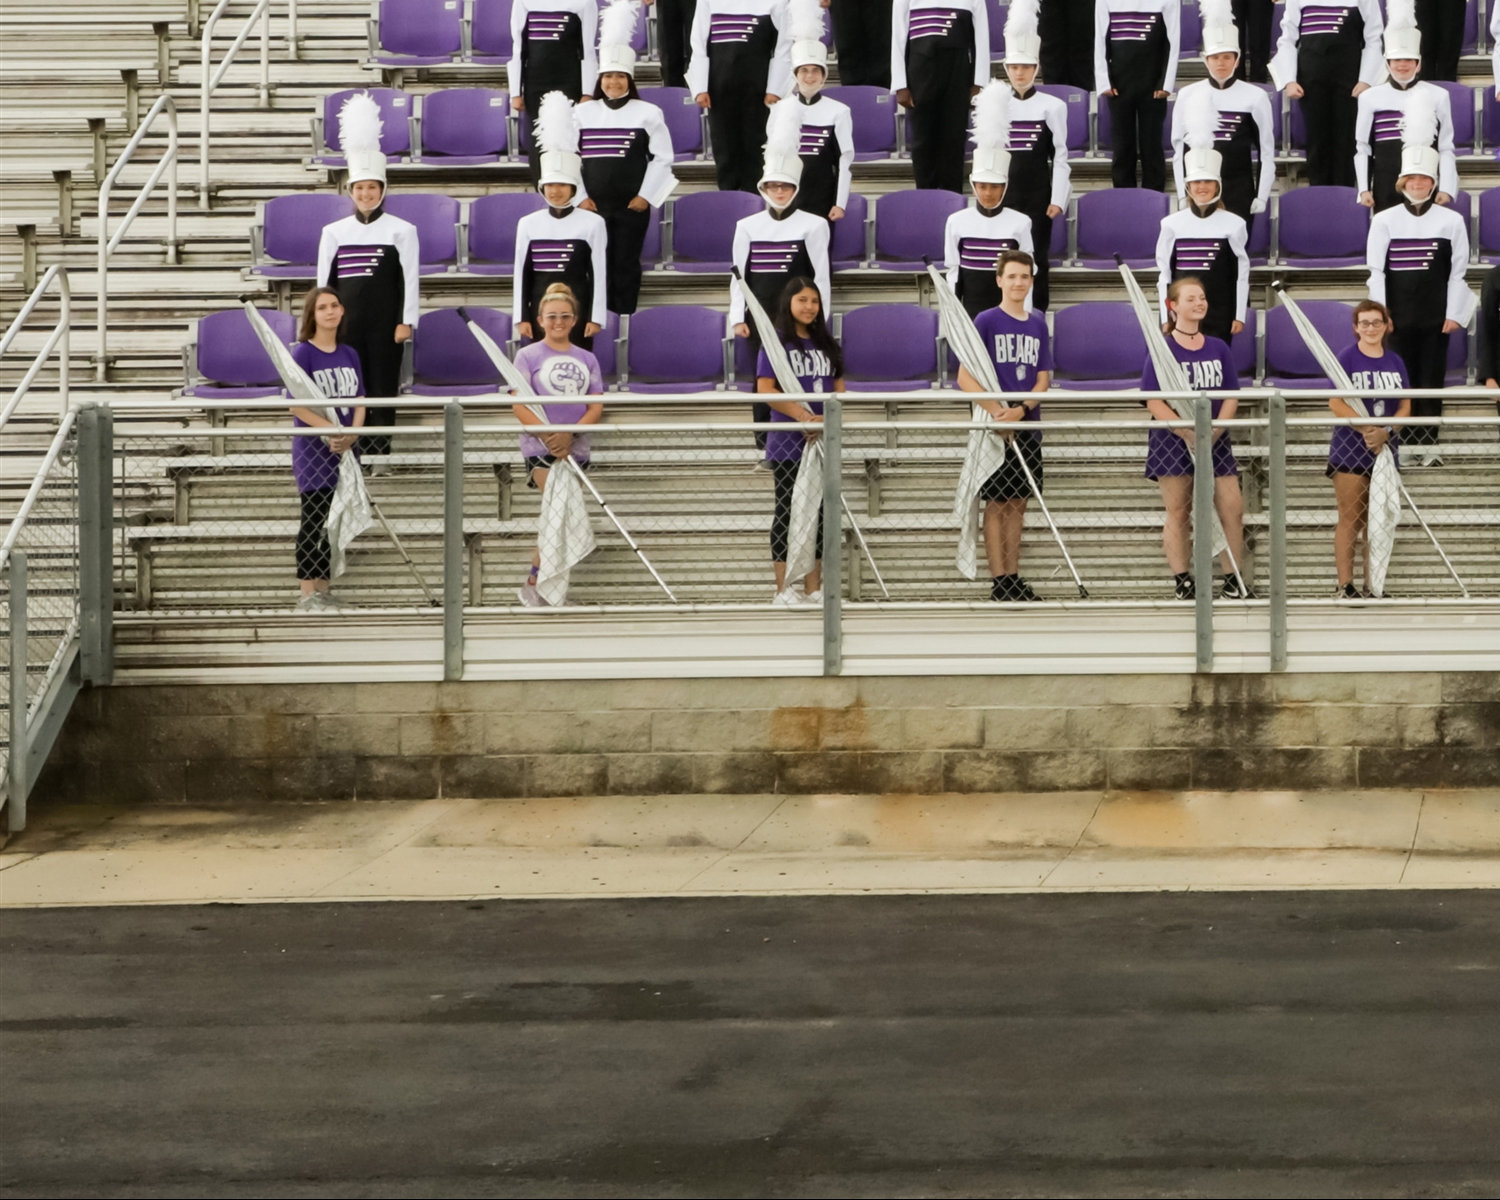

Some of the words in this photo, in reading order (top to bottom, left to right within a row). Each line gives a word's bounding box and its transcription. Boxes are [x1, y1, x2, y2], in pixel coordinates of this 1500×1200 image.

[789, 348, 836, 377] BEAR
[995, 334, 1041, 367] BEARS
[1180, 359, 1223, 390] EARS
